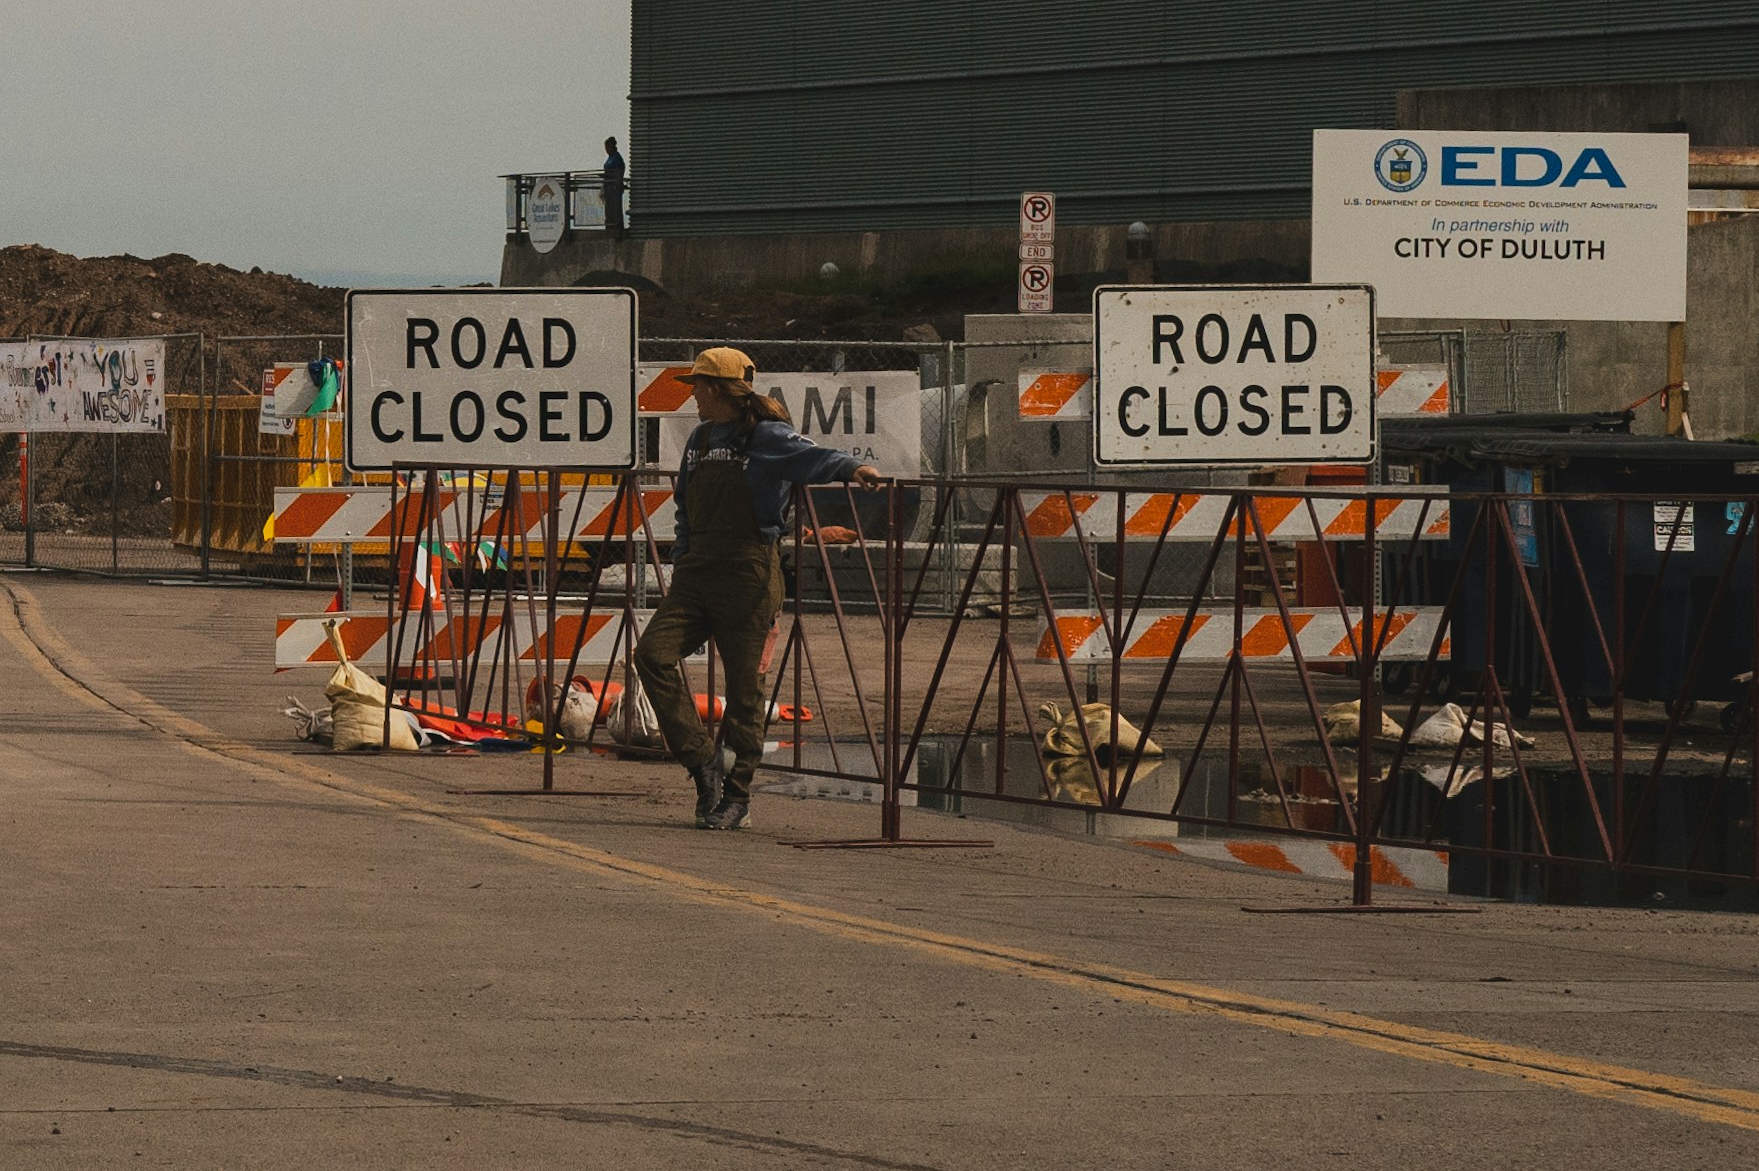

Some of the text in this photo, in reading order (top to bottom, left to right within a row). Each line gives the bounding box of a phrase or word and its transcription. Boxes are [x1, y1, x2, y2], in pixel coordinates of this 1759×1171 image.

[1441, 146, 1627, 188] EDA
[1343, 198, 1363, 206] U.S.
[1365, 198, 1418, 207] DEPARTMENT
[1435, 199, 1479, 207] COMMERCE
[1482, 200, 1526, 208] ECONOMIC
[1529, 201, 1587, 209] DEVELOPMENT
[1432, 218, 1569, 234] In partnership with
[1027, 247, 1045, 257] END
[1394, 238, 1605, 260] CITY OF DULUTH
[406, 317, 577, 369] ROAD
[1152, 313, 1317, 364] ROAD
[93, 349, 139, 388] YOU
[82, 389, 151, 424] AWESOME
[370, 390, 613, 443] CLOSED
[1118, 384, 1352, 437] CLOSED
[853, 446, 879, 460] PA.
